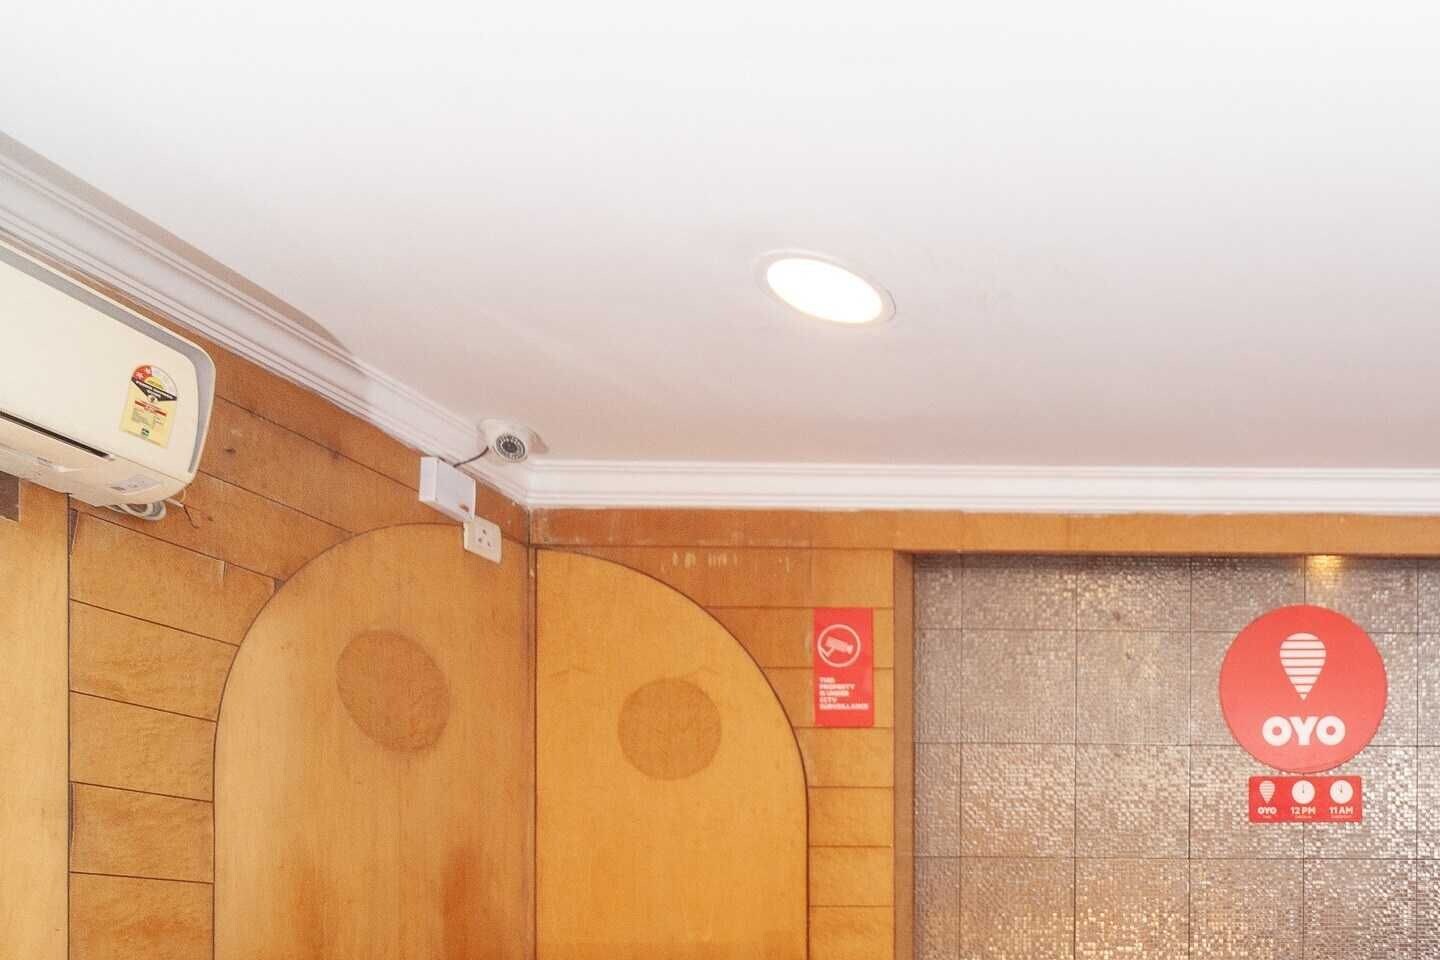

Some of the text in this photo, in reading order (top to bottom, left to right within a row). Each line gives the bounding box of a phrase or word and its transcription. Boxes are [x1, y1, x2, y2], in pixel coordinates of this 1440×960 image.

[1262, 715, 1346, 746] OYO
[1257, 807, 1277, 815] OYO
[1291, 806, 1316, 814] 12 PM
[1330, 806, 1353, 814] 11 AM
